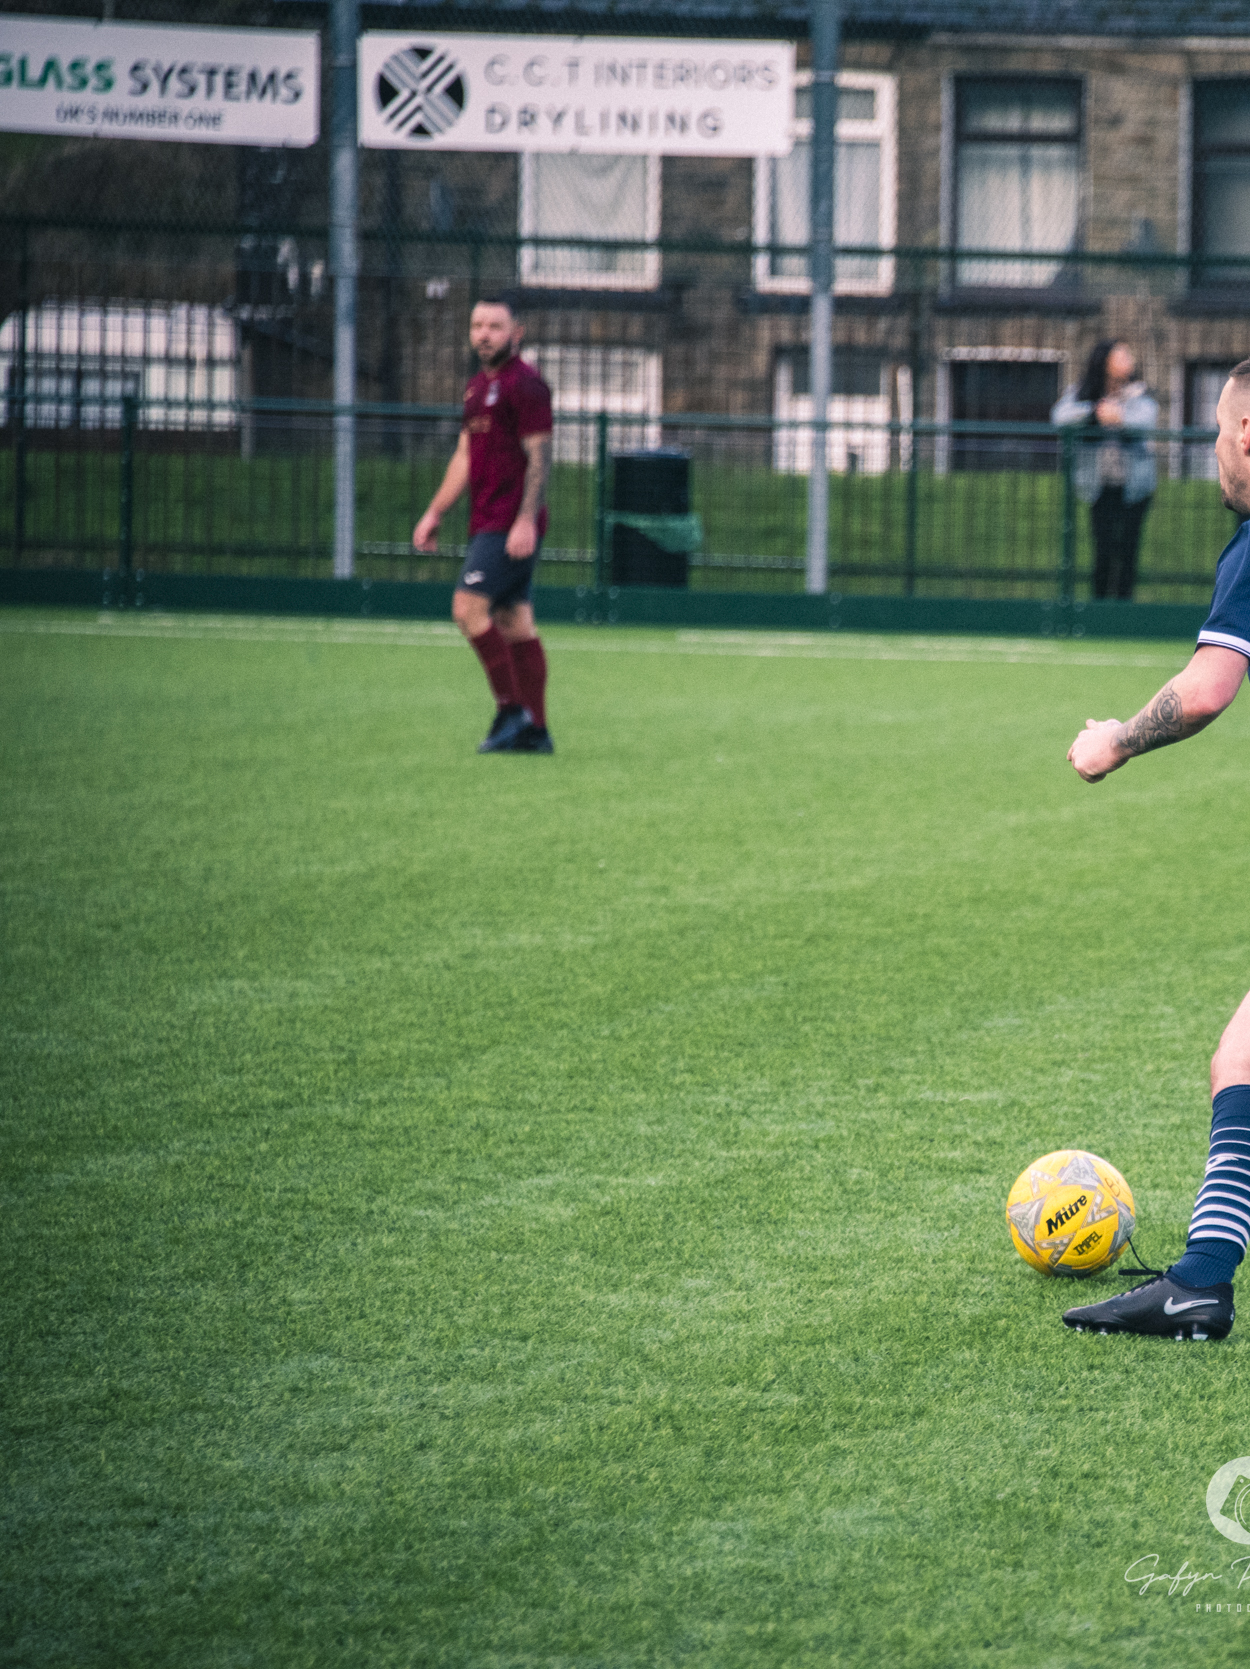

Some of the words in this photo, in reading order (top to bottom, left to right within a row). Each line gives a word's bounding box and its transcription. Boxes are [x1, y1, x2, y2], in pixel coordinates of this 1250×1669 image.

[127, 59, 304, 106] SYSTEMS
[593, 56, 781, 91] INTERIORS
[101, 104, 180, 129] NUMBER
[183, 107, 223, 131] ONE
[484, 102, 725, 139] DRYLINING
[1045, 1195, 1088, 1237] Mitre
[1073, 1231, 1103, 1256] IMPEL
